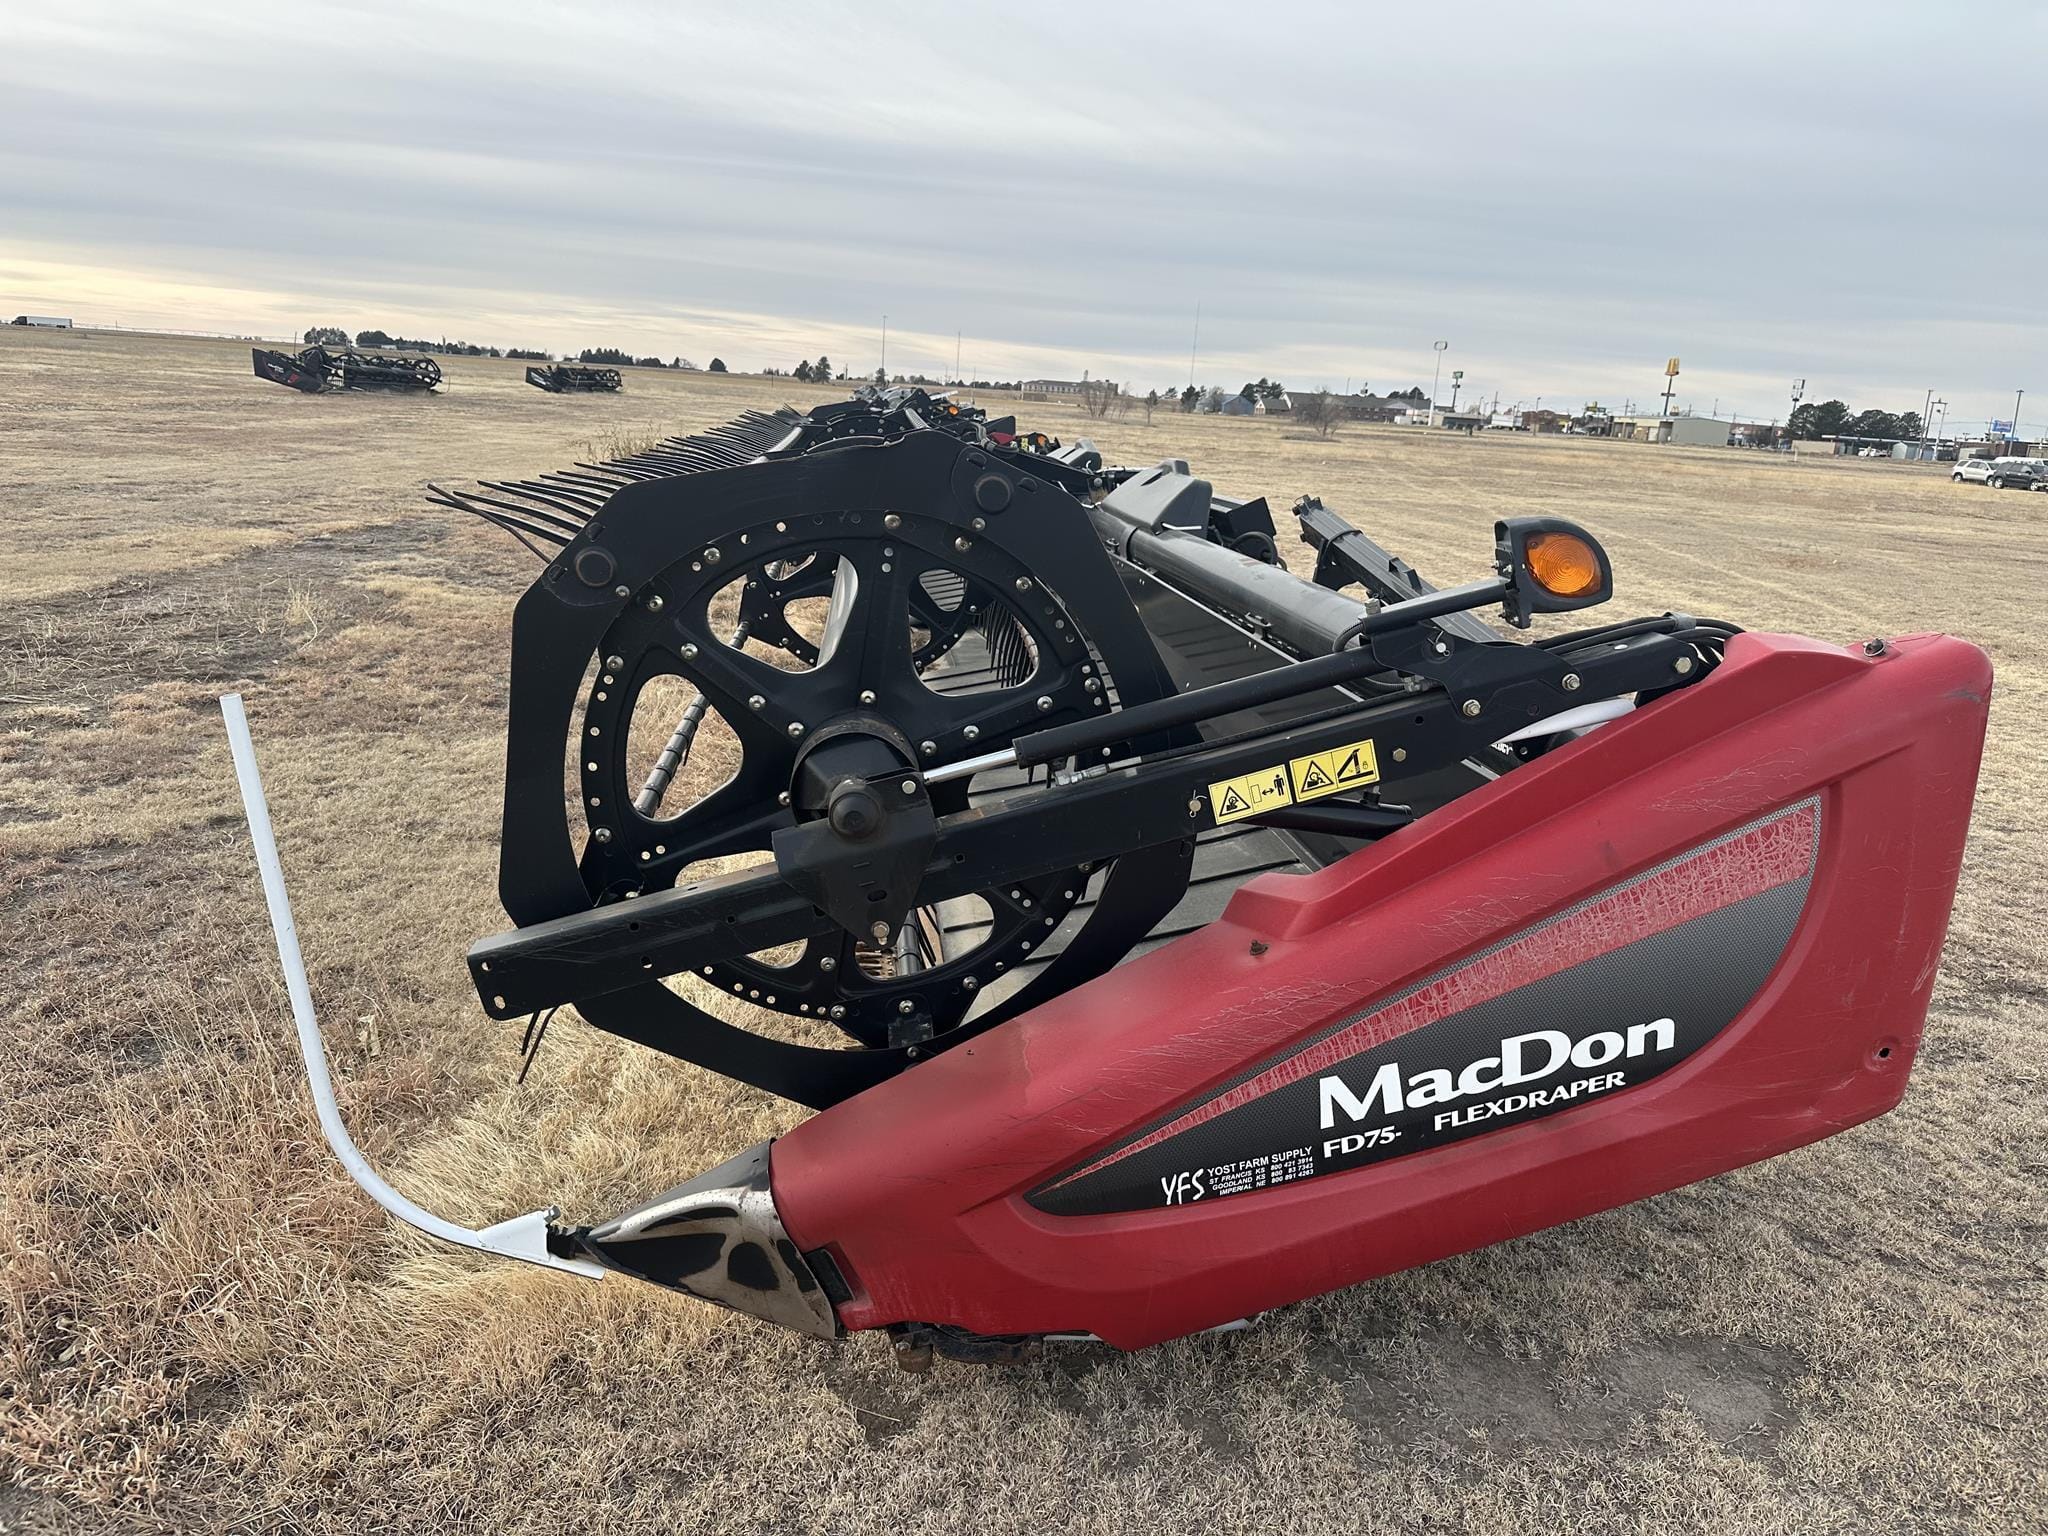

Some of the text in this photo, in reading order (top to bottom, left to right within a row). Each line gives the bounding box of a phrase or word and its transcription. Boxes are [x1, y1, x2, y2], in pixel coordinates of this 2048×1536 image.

[1319, 1017, 1675, 1130] MacDon
[1434, 1071, 1626, 1131] FLEXDRAPER
[1207, 1146, 1312, 1177] YOST FARM SUPPLY
[1209, 1177, 1218, 1185] ST
[1221, 1170, 1252, 1182] FRANCIS
[1255, 1167, 1265, 1175] KS
[1161, 1168, 1205, 1205] YFS
[1212, 1177, 1253, 1191] GOODLAND
[1255, 1173, 1266, 1181] KS
[1219, 1183, 1253, 1196] IMPERIAL
[1255, 1180, 1266, 1188] NE
